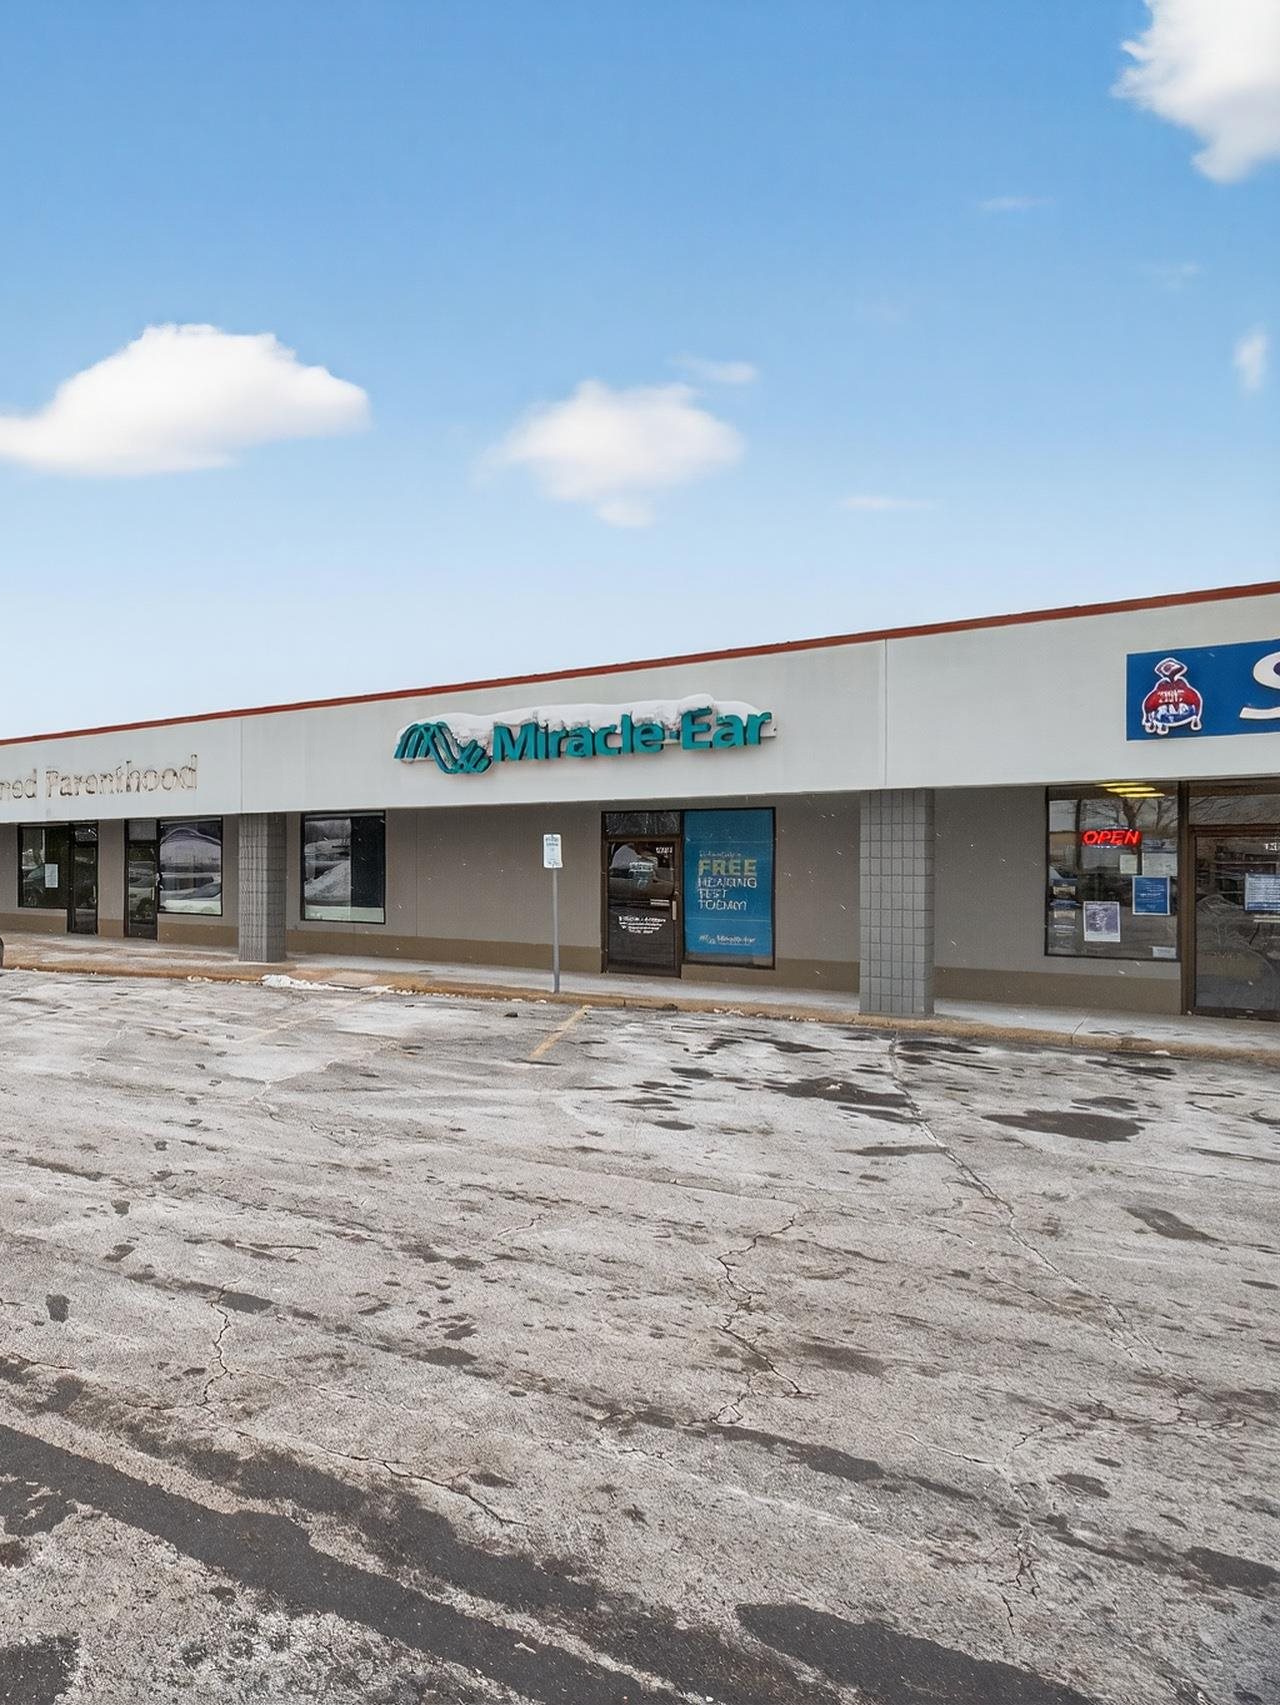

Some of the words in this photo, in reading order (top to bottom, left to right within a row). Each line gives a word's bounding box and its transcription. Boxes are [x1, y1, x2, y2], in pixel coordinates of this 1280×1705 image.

[493, 706, 773, 762] Miracle-Ear
[45, 753, 198, 798] Parenthood
[1082, 829, 1140, 846] OPEN
[698, 859, 757, 876] FREE
[698, 888, 727, 899] TEST
